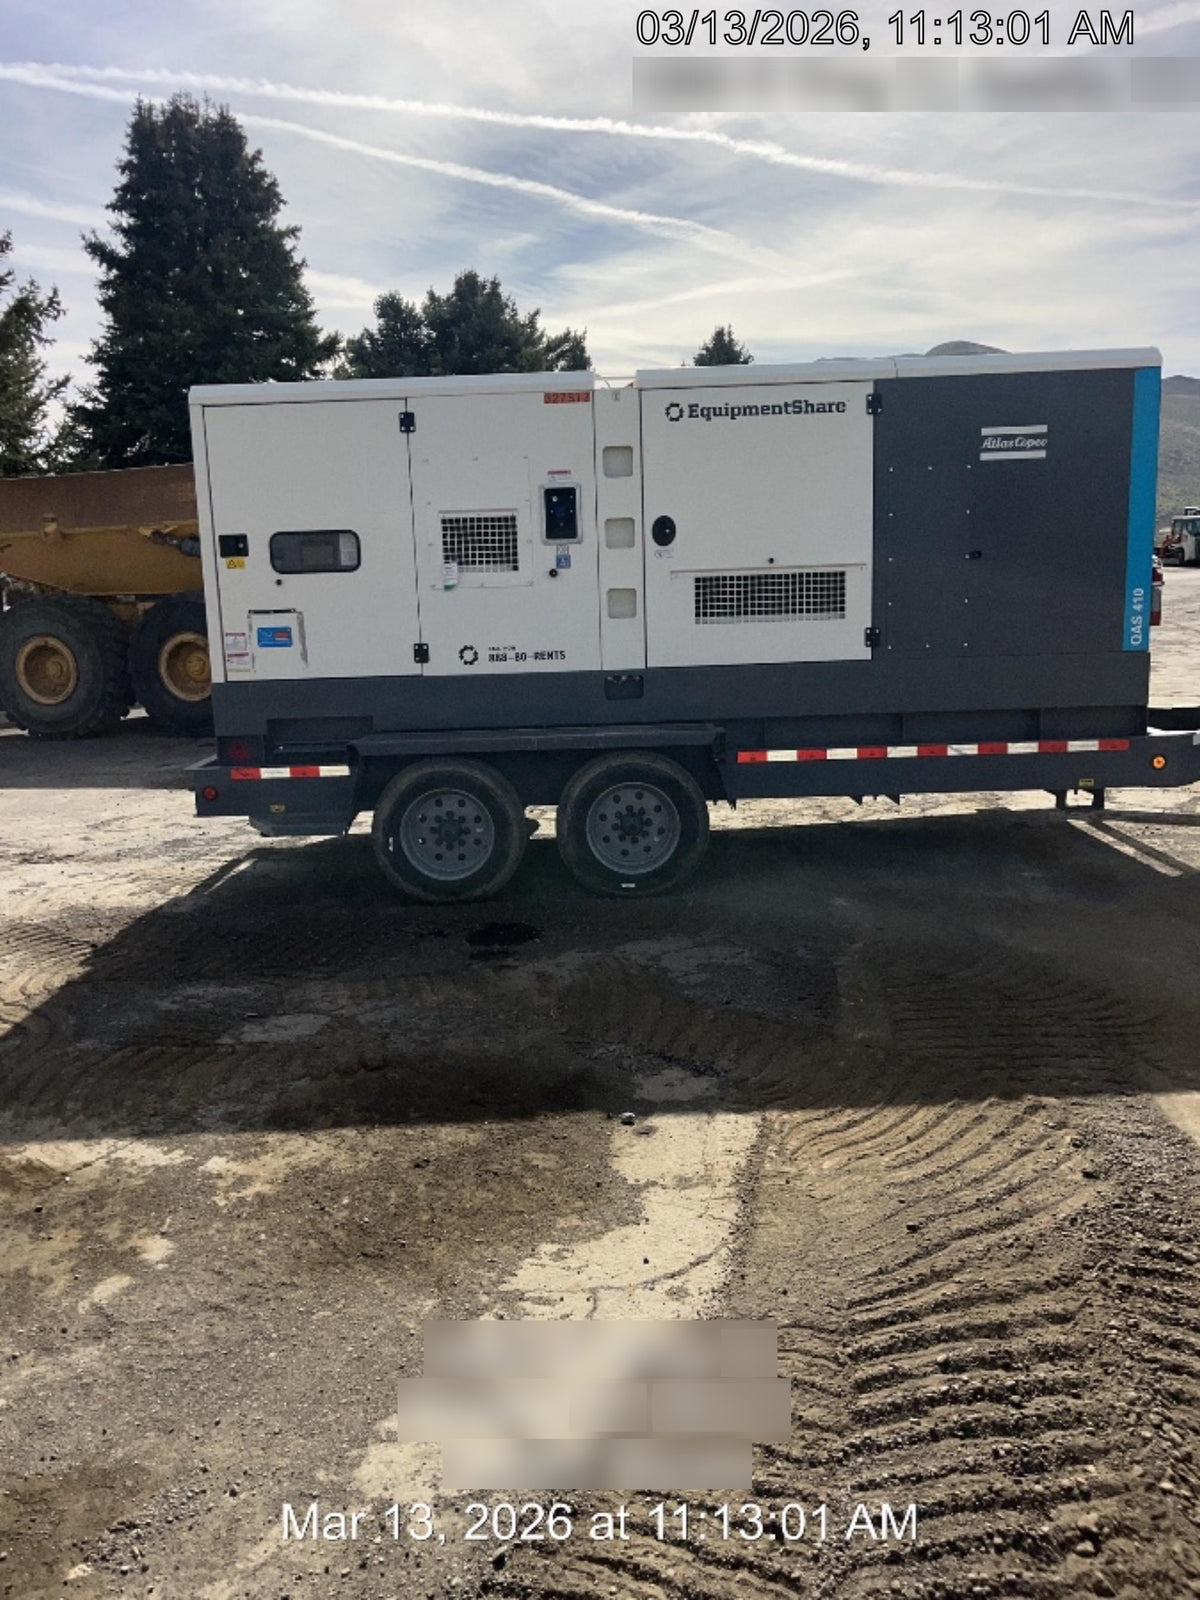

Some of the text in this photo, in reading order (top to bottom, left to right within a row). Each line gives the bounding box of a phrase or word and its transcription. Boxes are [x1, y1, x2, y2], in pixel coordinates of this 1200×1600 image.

[687, 399, 847, 421] EquipmentShare
[981, 436, 1015, 449] Atlas
[1130, 587, 1145, 646] QAS 410
